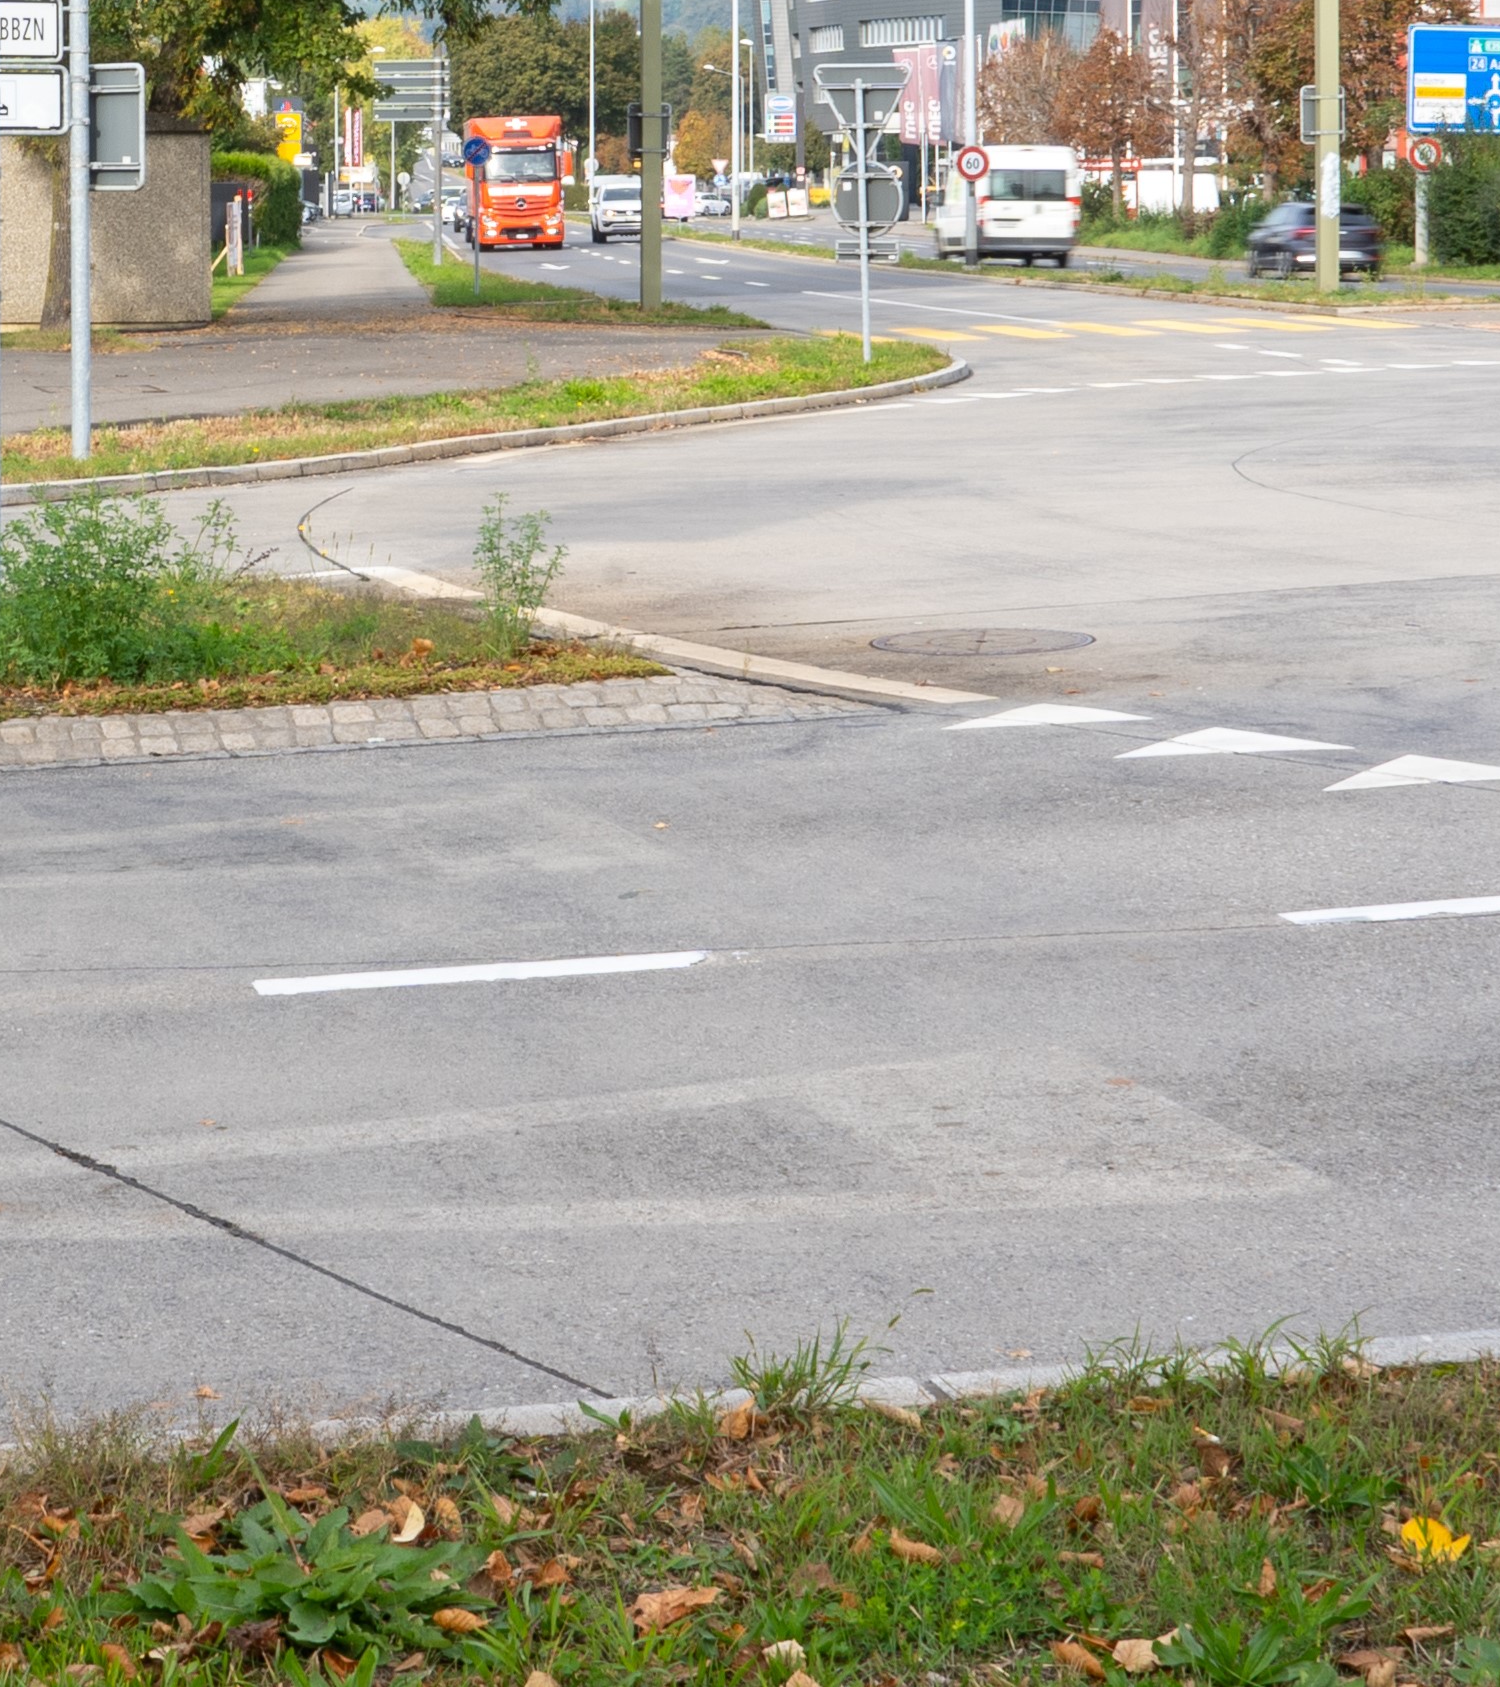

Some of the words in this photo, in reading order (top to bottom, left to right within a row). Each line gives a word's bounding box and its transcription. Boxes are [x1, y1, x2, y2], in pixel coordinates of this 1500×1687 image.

[0, 17, 45, 41] BBZN
[1471, 58, 1485, 70] 24
[966, 158, 980, 170] 60
